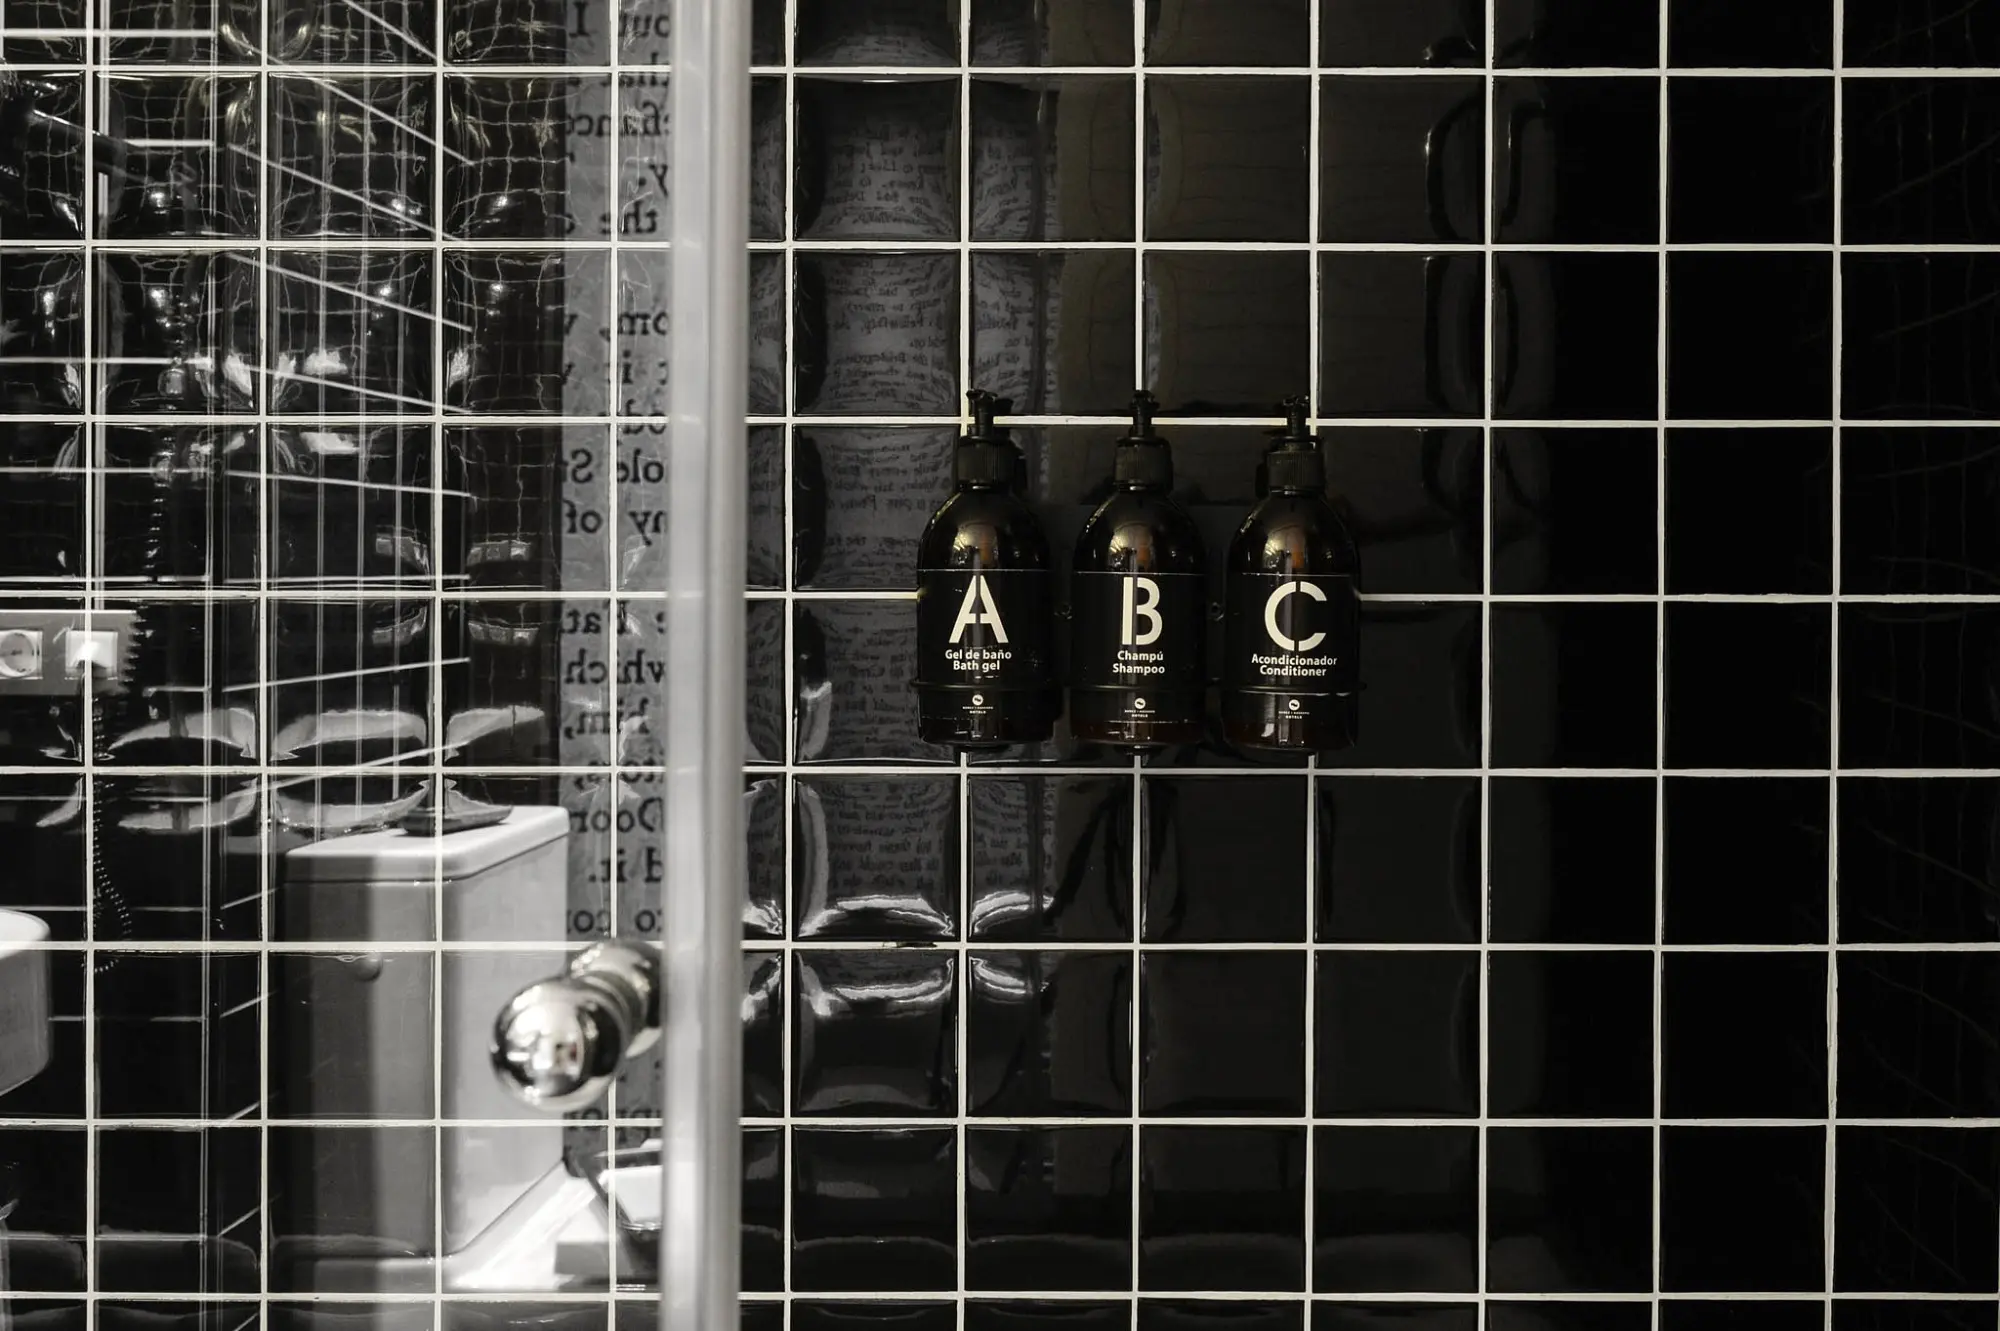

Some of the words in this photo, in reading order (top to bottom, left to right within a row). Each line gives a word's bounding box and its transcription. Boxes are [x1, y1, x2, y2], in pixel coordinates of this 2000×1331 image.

[949, 575, 1008, 643] A
[1122, 577, 1162, 645] B
[1264, 581, 1327, 651] C
[945, 649, 963, 660] Gel
[965, 649, 980, 659] de
[982, 649, 1012, 660] baño
[1117, 650, 1164, 663] Champú
[1251, 653, 1338, 666] Acondicionador
[953, 660, 979, 671] Bath
[982, 660, 1000, 673] gel
[1112, 663, 1165, 676] Shampoo
[1260, 665, 1327, 677] Conditioner
